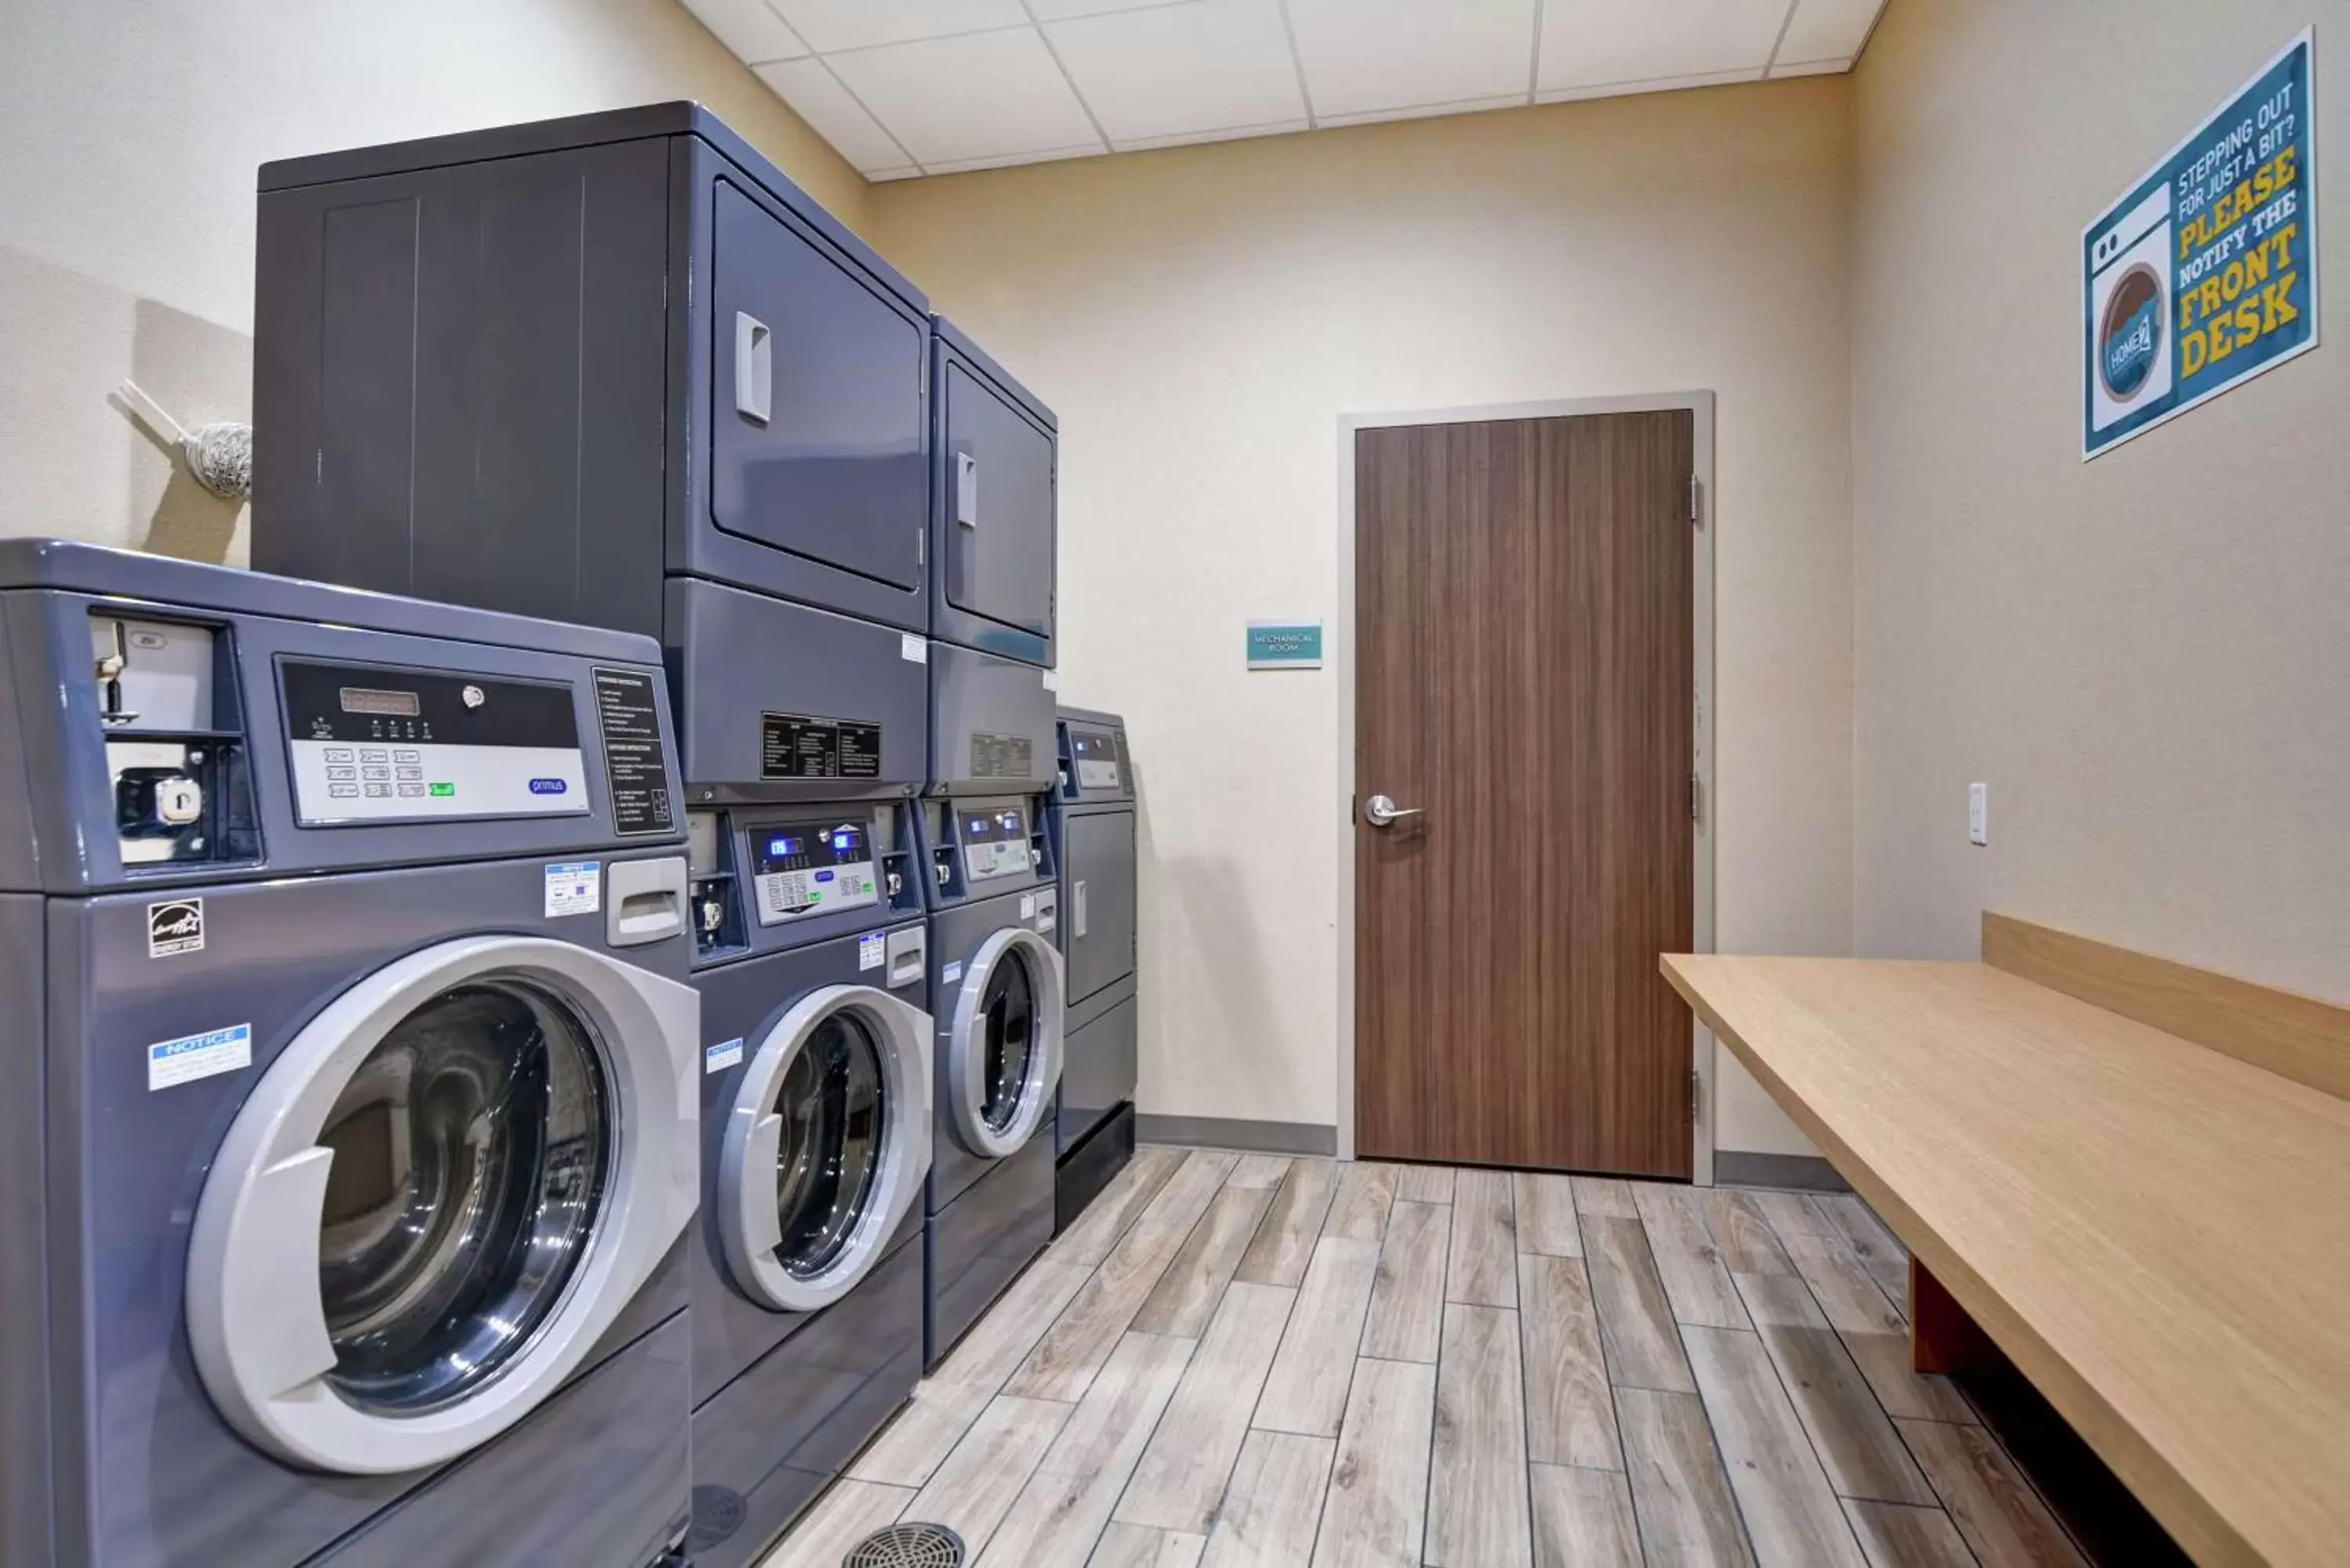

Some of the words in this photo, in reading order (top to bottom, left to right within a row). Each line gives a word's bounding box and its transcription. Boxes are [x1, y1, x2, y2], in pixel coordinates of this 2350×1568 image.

[2178, 119, 2253, 196] STEPPING
[2258, 82, 2294, 129] OUT
[2179, 188, 2204, 222] FOR
[2207, 155, 2243, 201] JUST
[2244, 147, 2256, 171] A
[2259, 114, 2295, 159] BIT?
[2180, 145, 2296, 259] PLEASE
[2180, 224, 2247, 288] NOTIFY
[2252, 189, 2297, 237] THE
[2180, 222, 2297, 330] FRONT
[2180, 271, 2298, 379] DESK
[533, 780, 563, 792] primus
[167, 1030, 234, 1055] NOTICE
